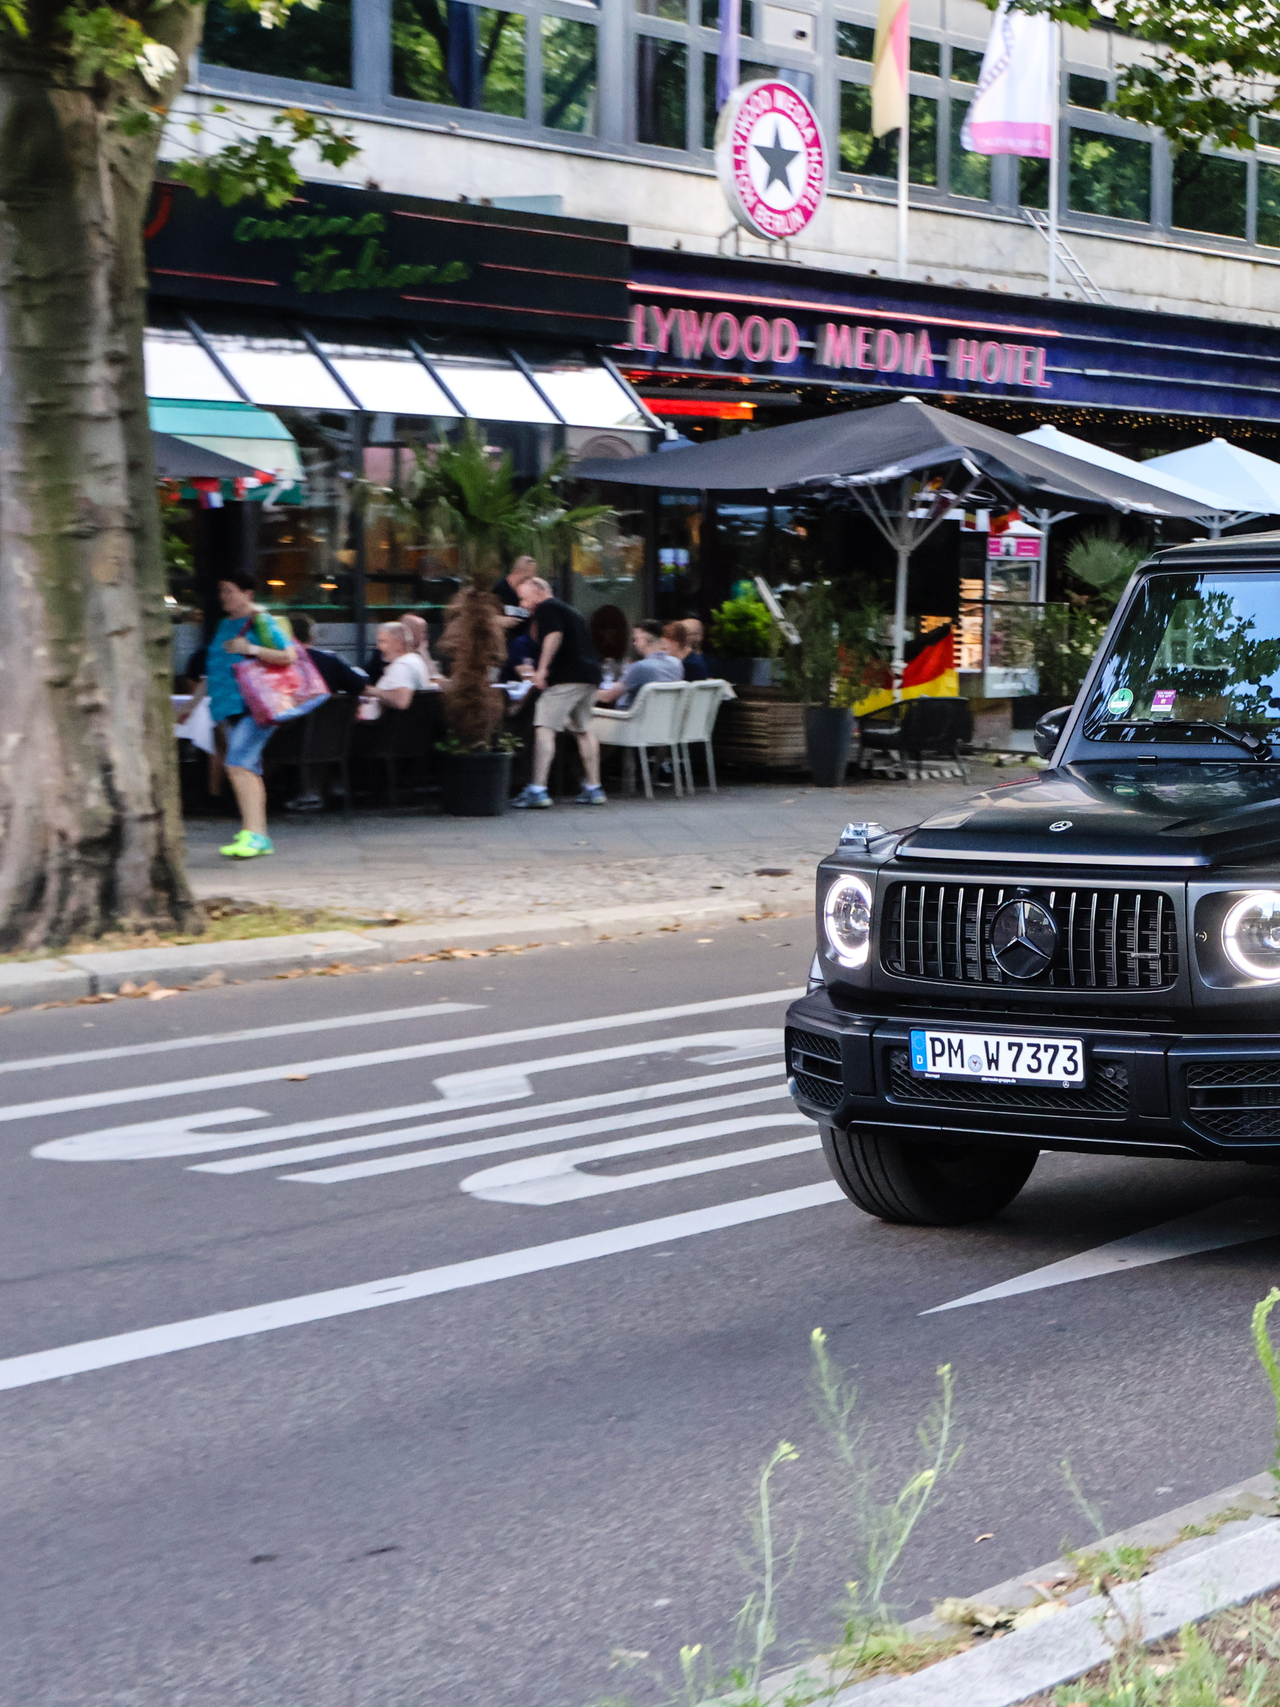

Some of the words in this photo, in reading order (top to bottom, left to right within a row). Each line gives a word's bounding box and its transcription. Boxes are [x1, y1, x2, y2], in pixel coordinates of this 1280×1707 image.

[612, 303, 800, 364] LYWOOD
[815, 322, 935, 378] MEDIA
[947, 337, 1053, 389] HOTEL
[916, 1055, 924, 1065] D
[929, 1037, 965, 1068] PM
[984, 1040, 1000, 1071] W
[1007, 1041, 1079, 1076] 7373
